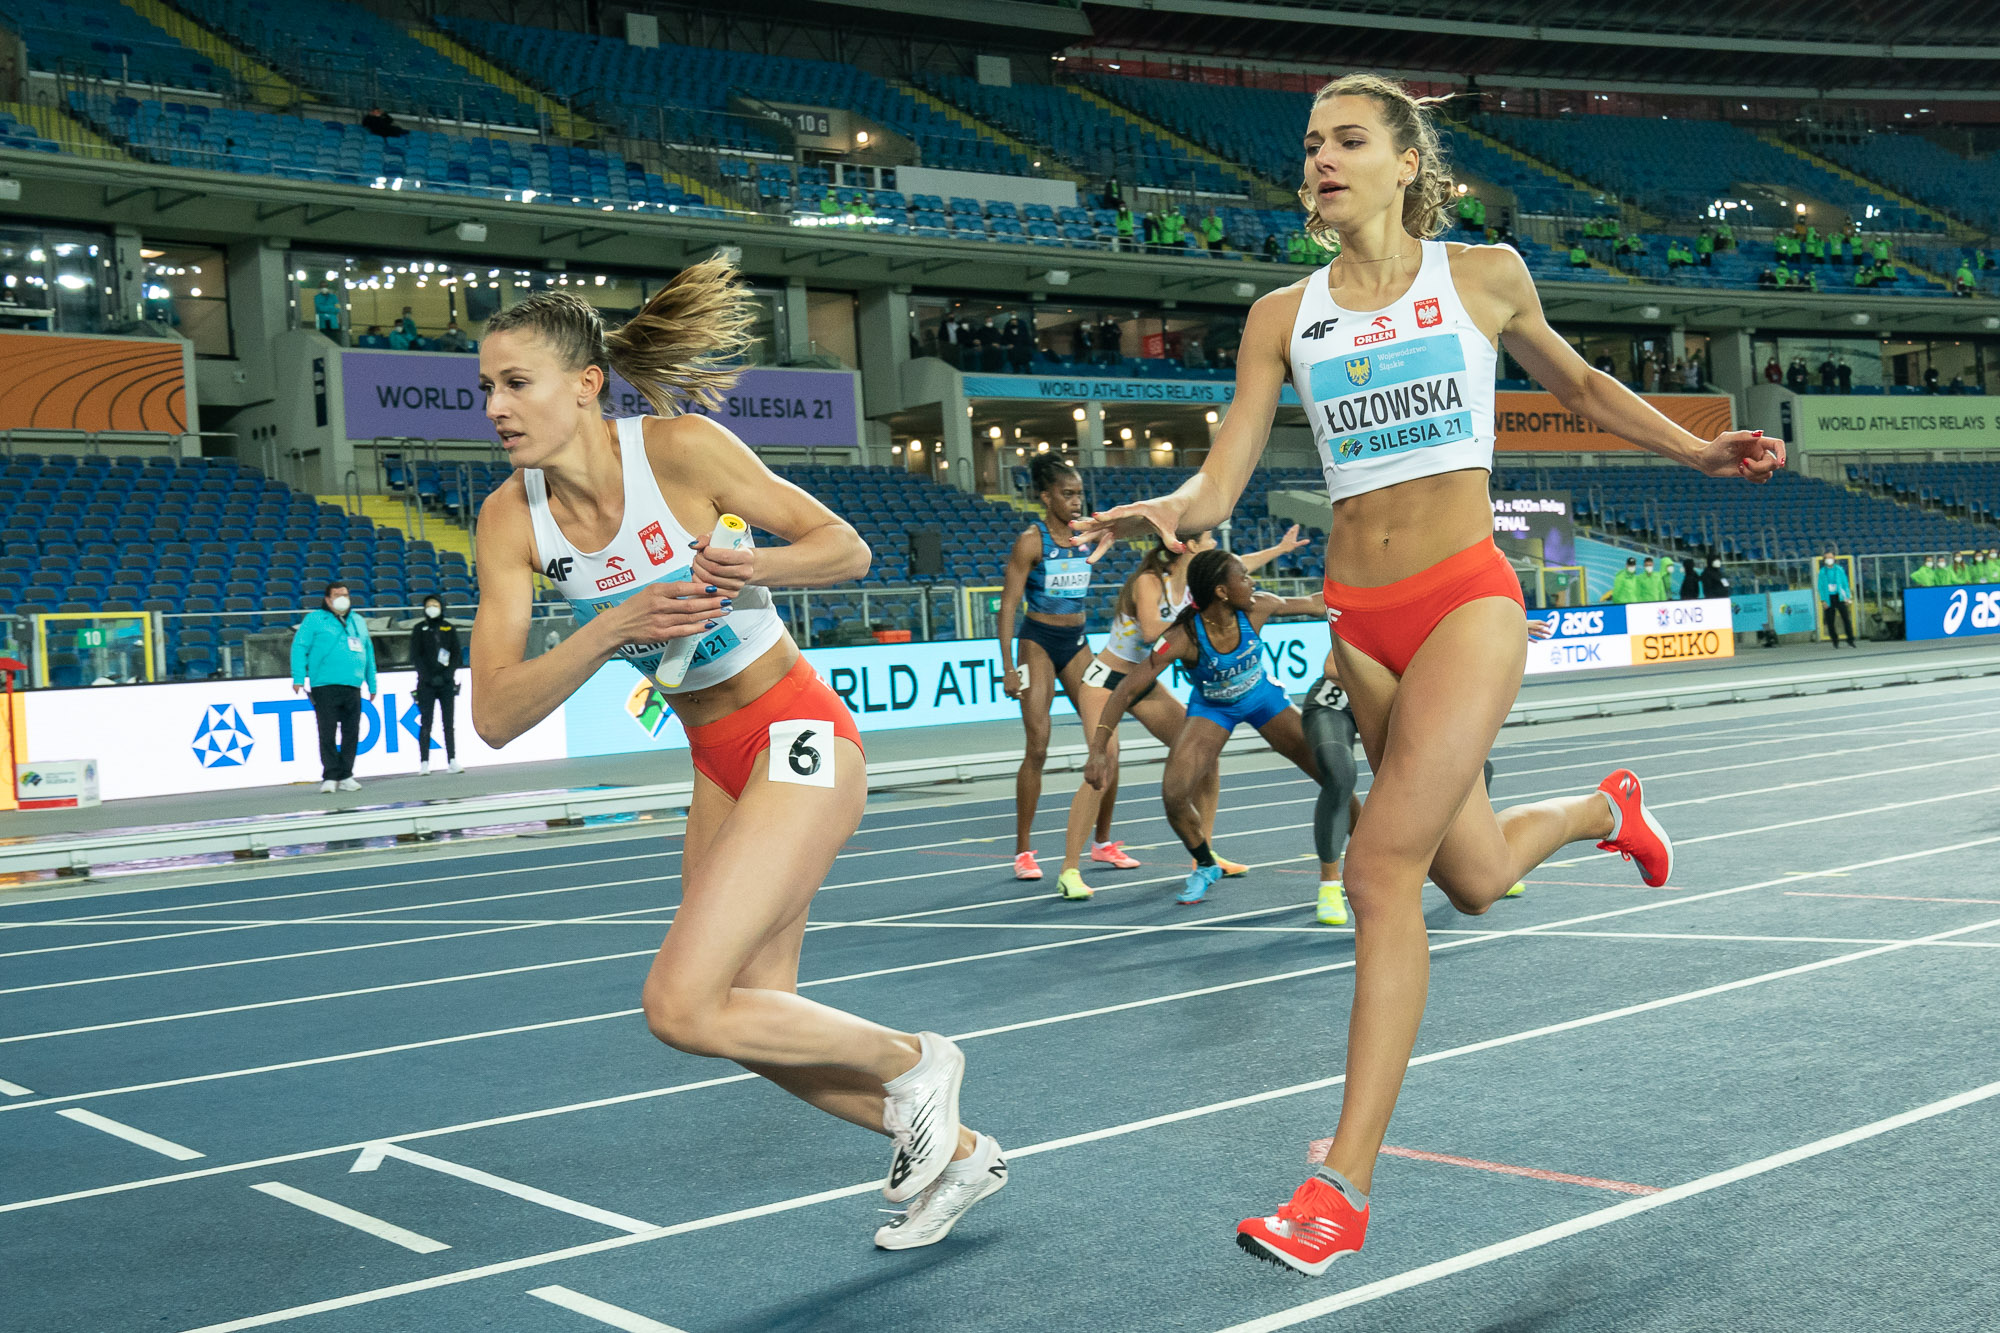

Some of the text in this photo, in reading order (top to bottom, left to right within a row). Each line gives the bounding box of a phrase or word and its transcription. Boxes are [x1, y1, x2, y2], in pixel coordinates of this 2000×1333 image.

[797, 114, 816, 132] 10
[1356, 330, 1394, 346] ORLEN
[1377, 346, 1427, 361] Województwo
[1039, 382, 1088, 397] WORLD
[1092, 383, 1163, 399] ATHLETICS
[1166, 386, 1214, 400] RELAYS
[376, 386, 474, 410] WORLD
[730, 397, 806, 418] SILESIA
[813, 399, 833, 419] 21
[1324, 378, 1462, 434] ŁOZOWSKA
[1818, 416, 1866, 431] WORLD
[1869, 416, 1937, 431] ATHLETICS
[1939, 416, 1985, 430] RELAYS
[1370, 418, 1462, 452] SILESIA 21
[640, 523, 659, 538] POLSKA
[1494, 516, 1530, 531] FINAL
[599, 571, 632, 588] ORLEN
[1673, 607, 1704, 626] QNB
[84, 631, 102, 646] 10
[705, 635, 727, 657] 21
[1644, 631, 1720, 661] SEIKO
[1562, 643, 1602, 663] TDK
[1089, 664, 1103, 681] 7
[1325, 686, 1343, 706] 8
[789, 729, 822, 776] 6
